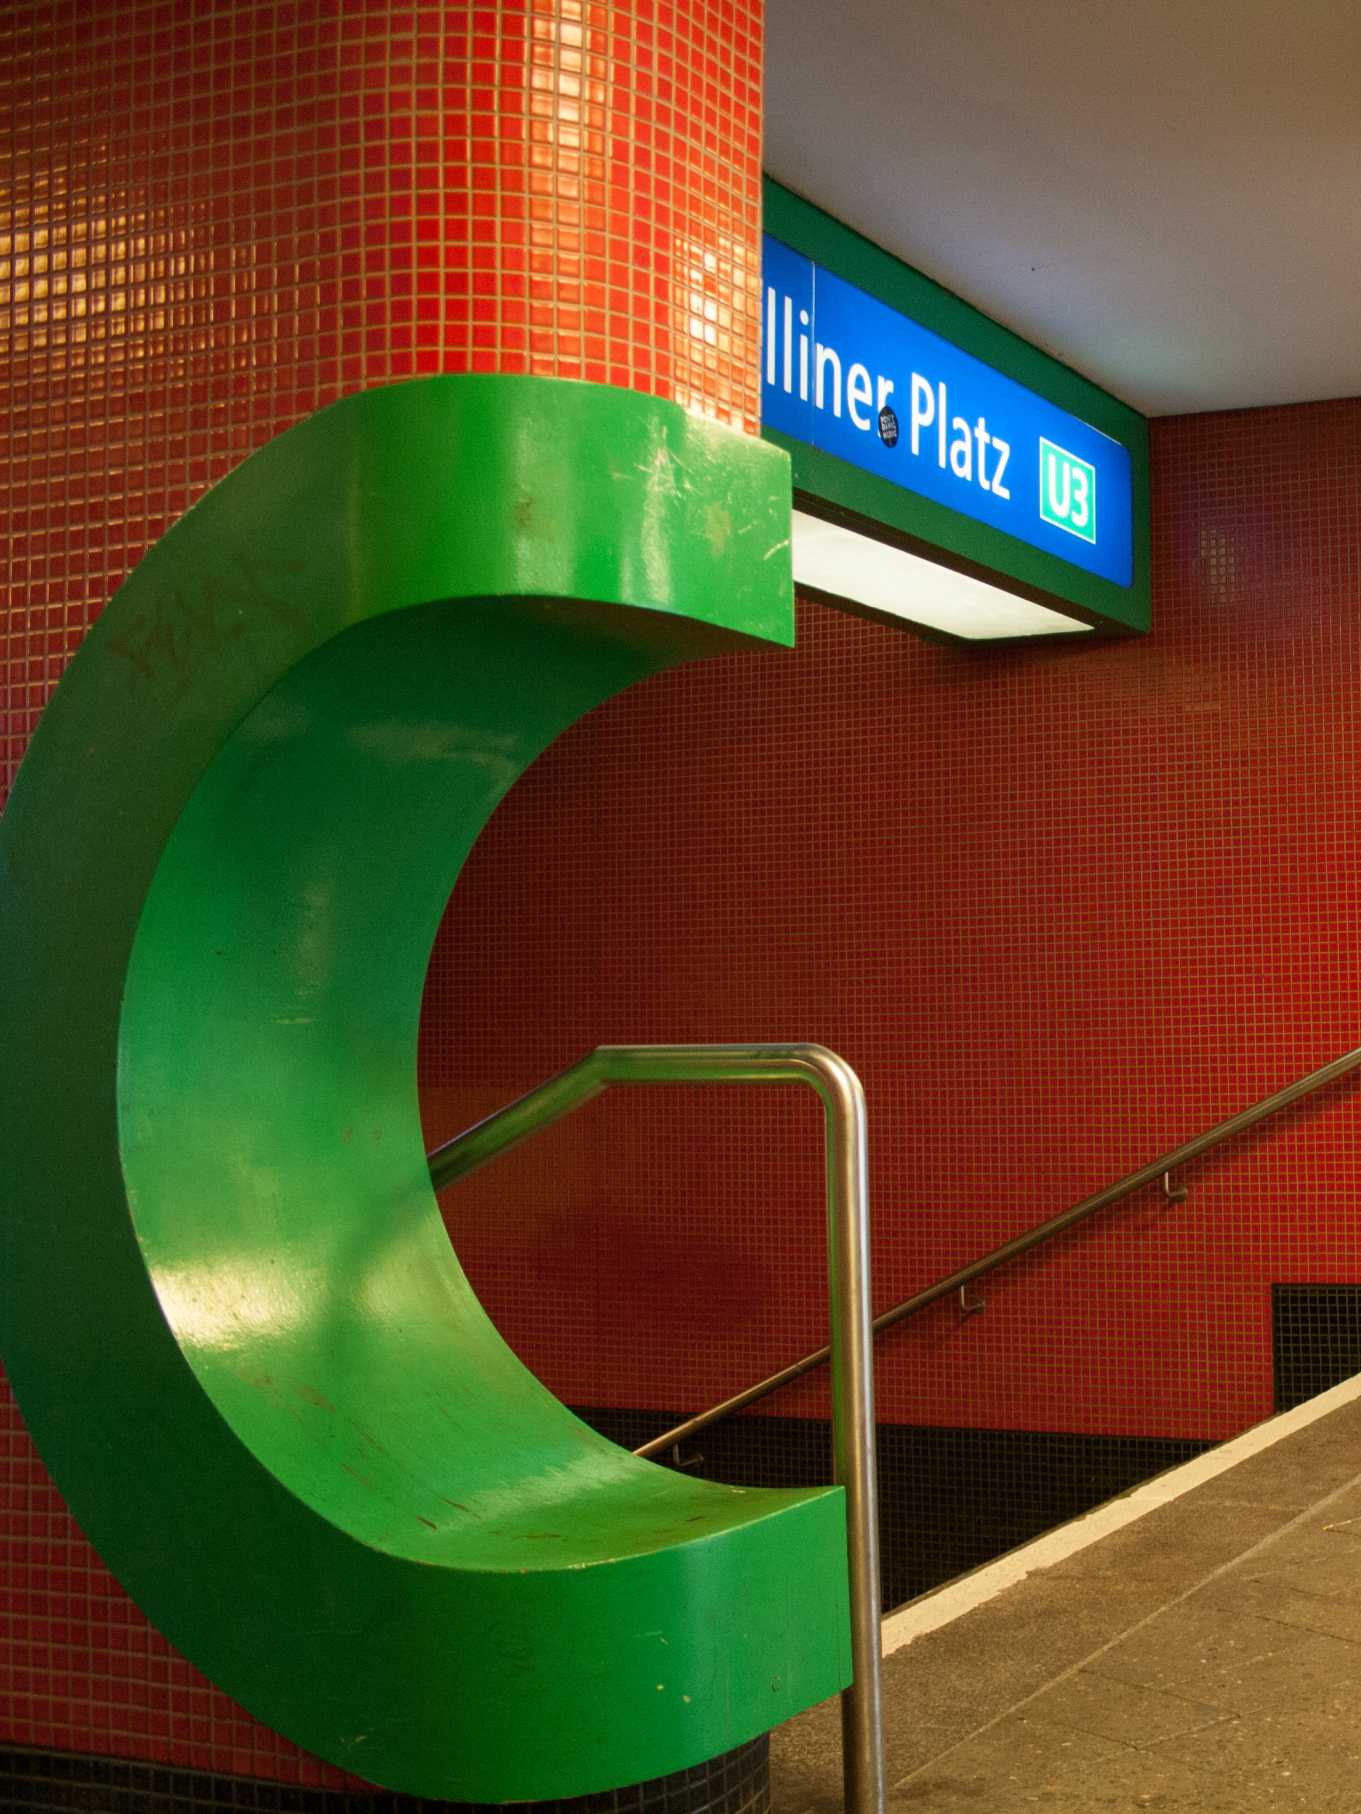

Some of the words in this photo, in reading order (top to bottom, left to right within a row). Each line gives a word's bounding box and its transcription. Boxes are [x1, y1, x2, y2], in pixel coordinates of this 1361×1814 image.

[766, 286, 894, 438] lliner
[911, 372, 1011, 500] Platz
[1047, 453, 1089, 528] U3
